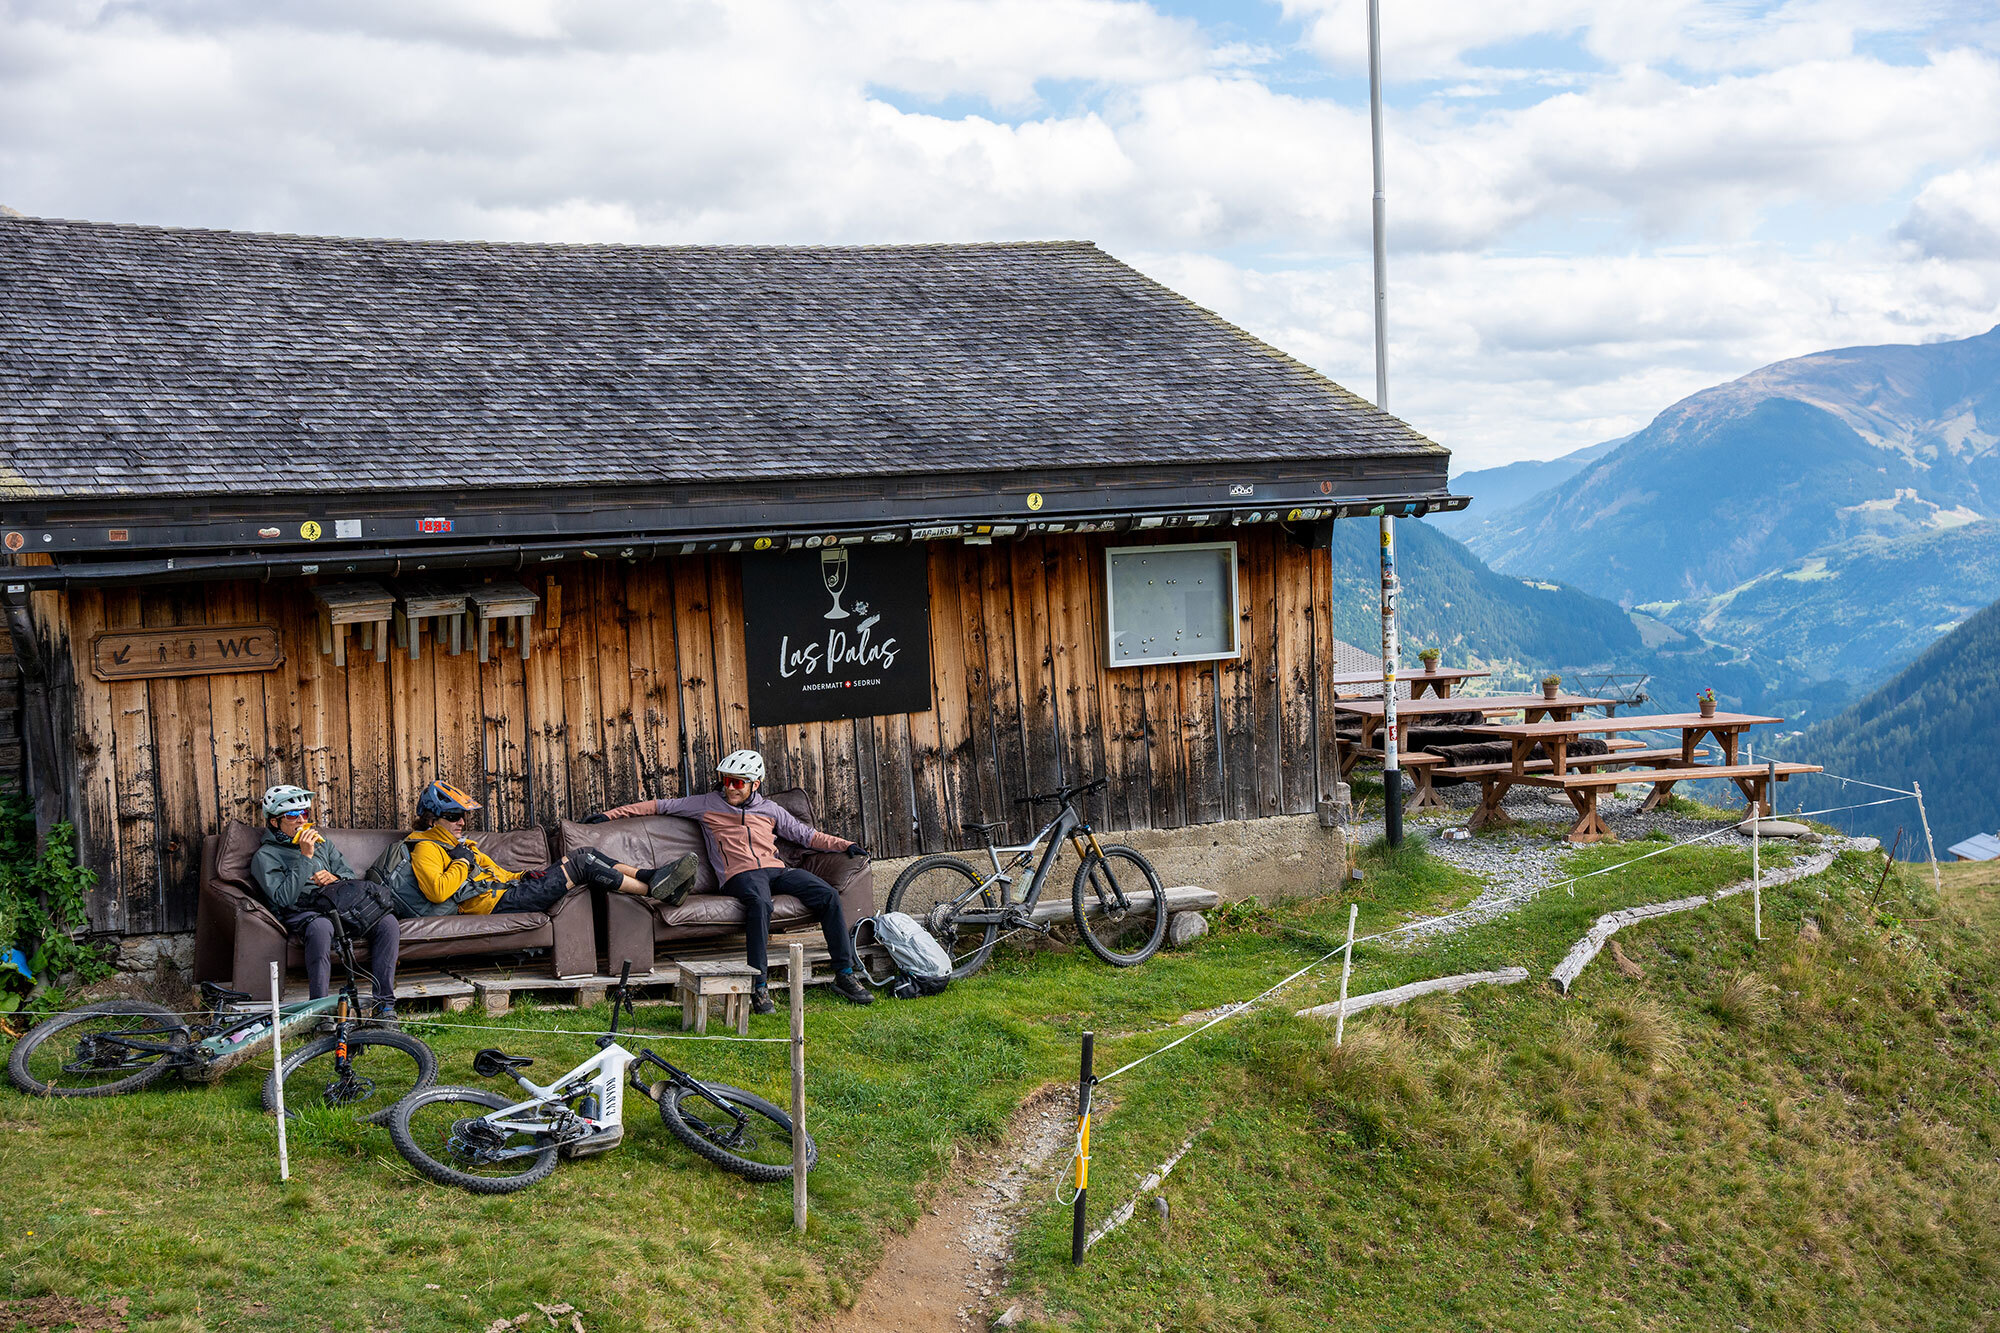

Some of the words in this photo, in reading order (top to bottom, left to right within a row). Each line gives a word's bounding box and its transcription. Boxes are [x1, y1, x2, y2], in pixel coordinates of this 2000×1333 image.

[417, 520, 451, 533] 1893
[216, 636, 262, 659] WC
[779, 634, 824, 679] Las
[826, 627, 901, 675] Palas
[801, 681, 844, 692] ANDERMATT
[852, 678, 882, 688] SEDRUN
[605, 1077, 617, 1117] CANYON
